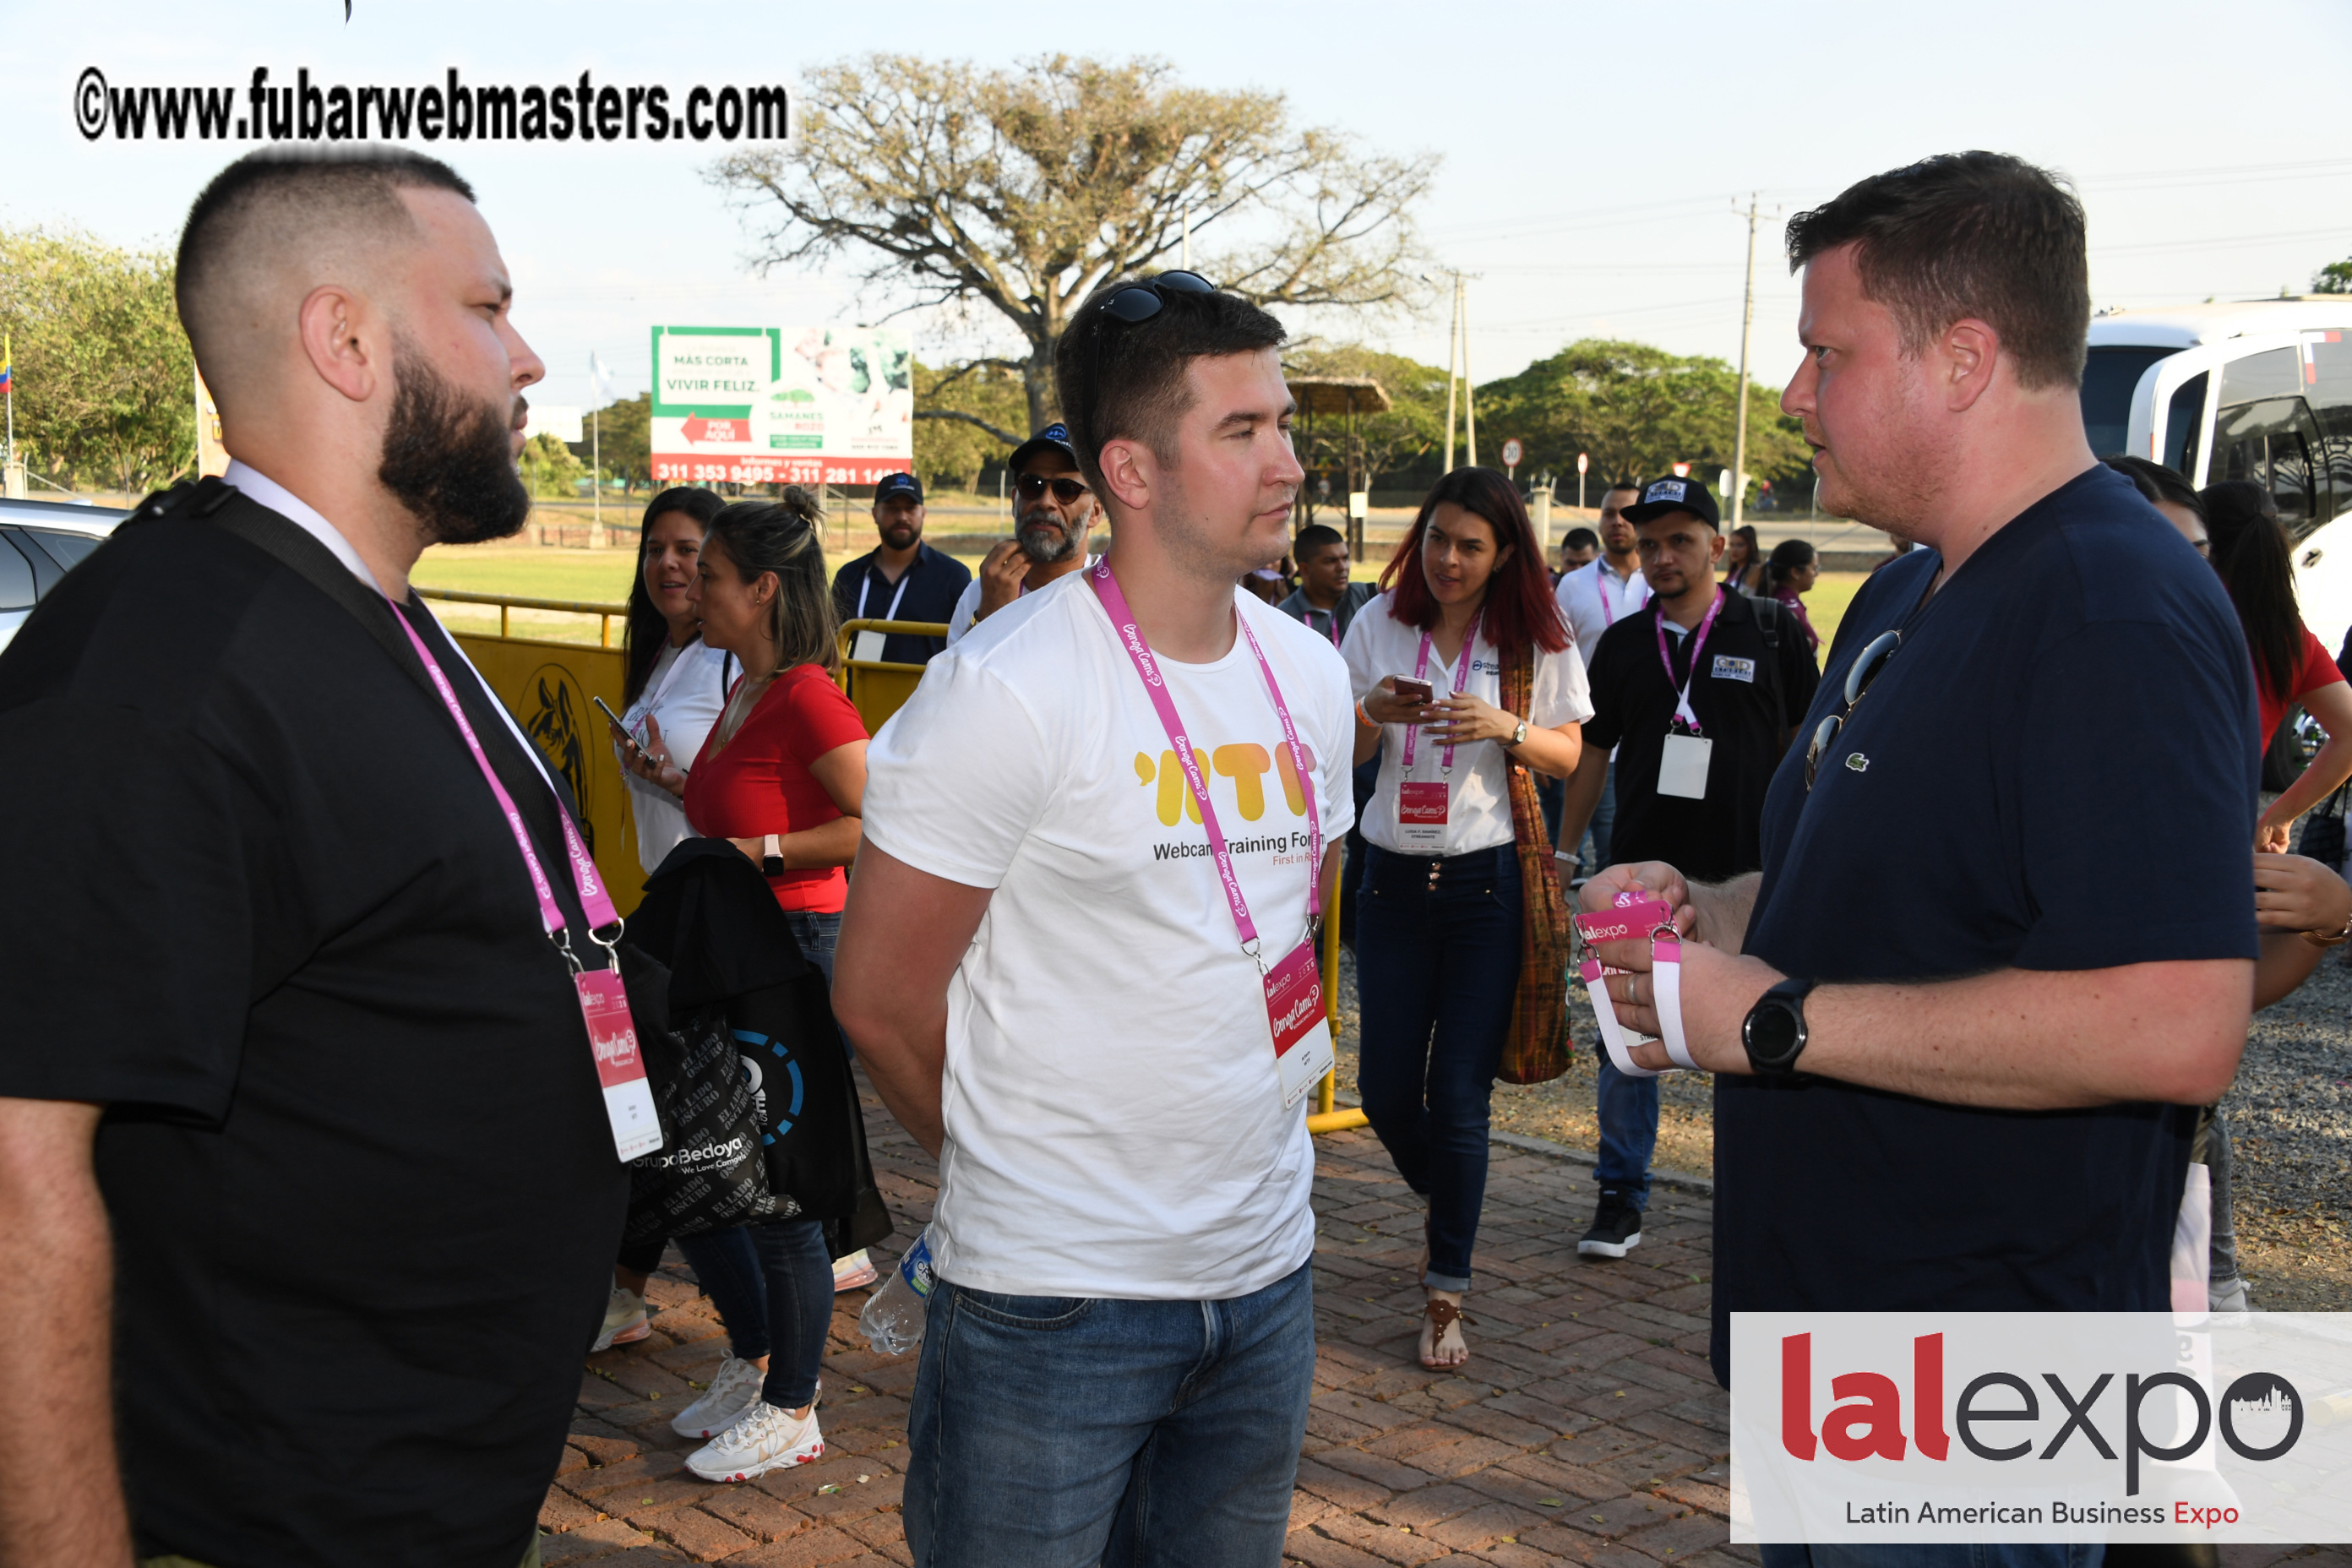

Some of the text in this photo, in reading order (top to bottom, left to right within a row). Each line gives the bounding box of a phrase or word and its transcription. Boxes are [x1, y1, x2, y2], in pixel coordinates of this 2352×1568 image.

[673, 352, 749, 367] MÁS CORTA
[666, 378, 760, 393] VIVIR FELIZ.
[707, 420, 732, 431] POR
[657, 464, 689, 480] 311
[694, 465, 727, 481] 353
[731, 465, 774, 482] 9495
[790, 466, 821, 483] 311
[825, 467, 857, 484] 281
[740, 456, 783, 468] Informes
[784, 459, 791, 469] y
[1272, 852, 1294, 866] First
[1296, 852, 1303, 862] in
[1266, 973, 1291, 999] lalexpo
[694, 1032, 719, 1059] LADO
[686, 1041, 724, 1079] OSCURO
[684, 1081, 713, 1108] LADO
[678, 1090, 720, 1127] OSCURO
[681, 1164, 695, 1175] We
[695, 1161, 716, 1173] Love
[716, 1152, 747, 1169] Camgirls
[670, 1183, 712, 1217] OSCURO
[676, 1175, 705, 1200] LADO
[725, 1178, 753, 1204] LADO
